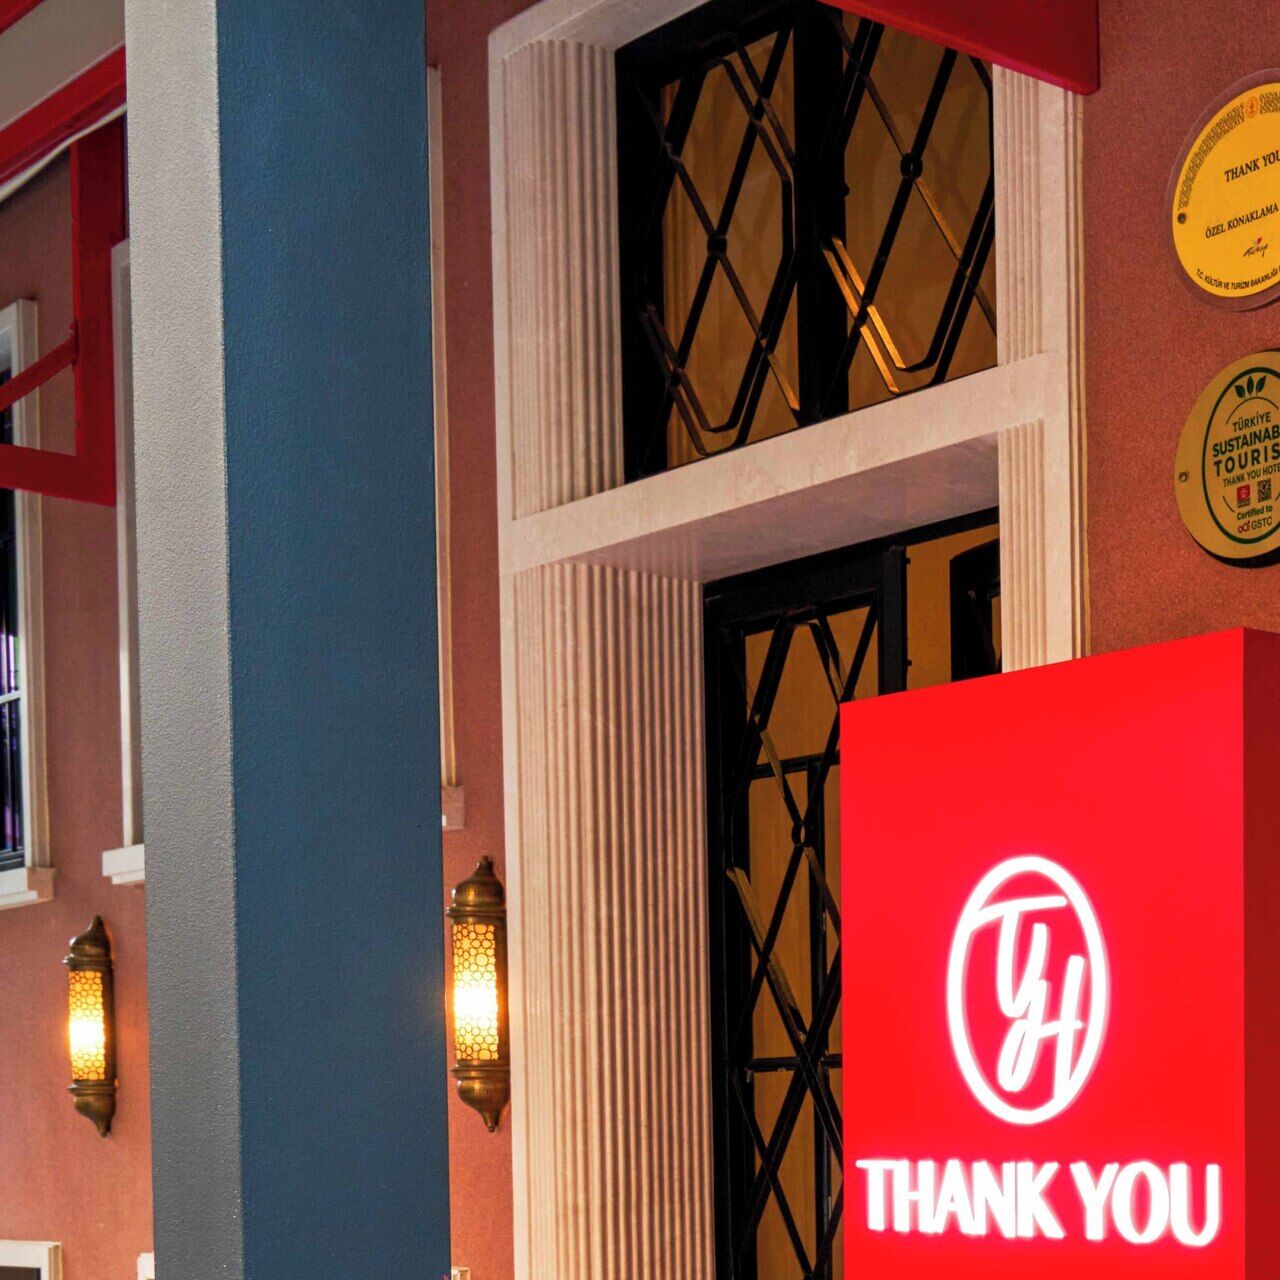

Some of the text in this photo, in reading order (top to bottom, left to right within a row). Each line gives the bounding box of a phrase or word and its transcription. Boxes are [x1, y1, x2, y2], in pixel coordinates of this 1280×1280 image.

[1224, 158, 1260, 182] THANK
[1205, 223, 1226, 239] ÖZEL
[1227, 203, 1279, 230] KONAKLAMA
[1232, 412, 1271, 432] TÜRKİYE
[1223, 472, 1245, 487] THANK
[1247, 468, 1261, 480] YOU
[1237, 505, 1273, 520] Certified to
[1251, 516, 1273, 529] GSTC
[855, 1158, 1221, 1247] THANK YOU
